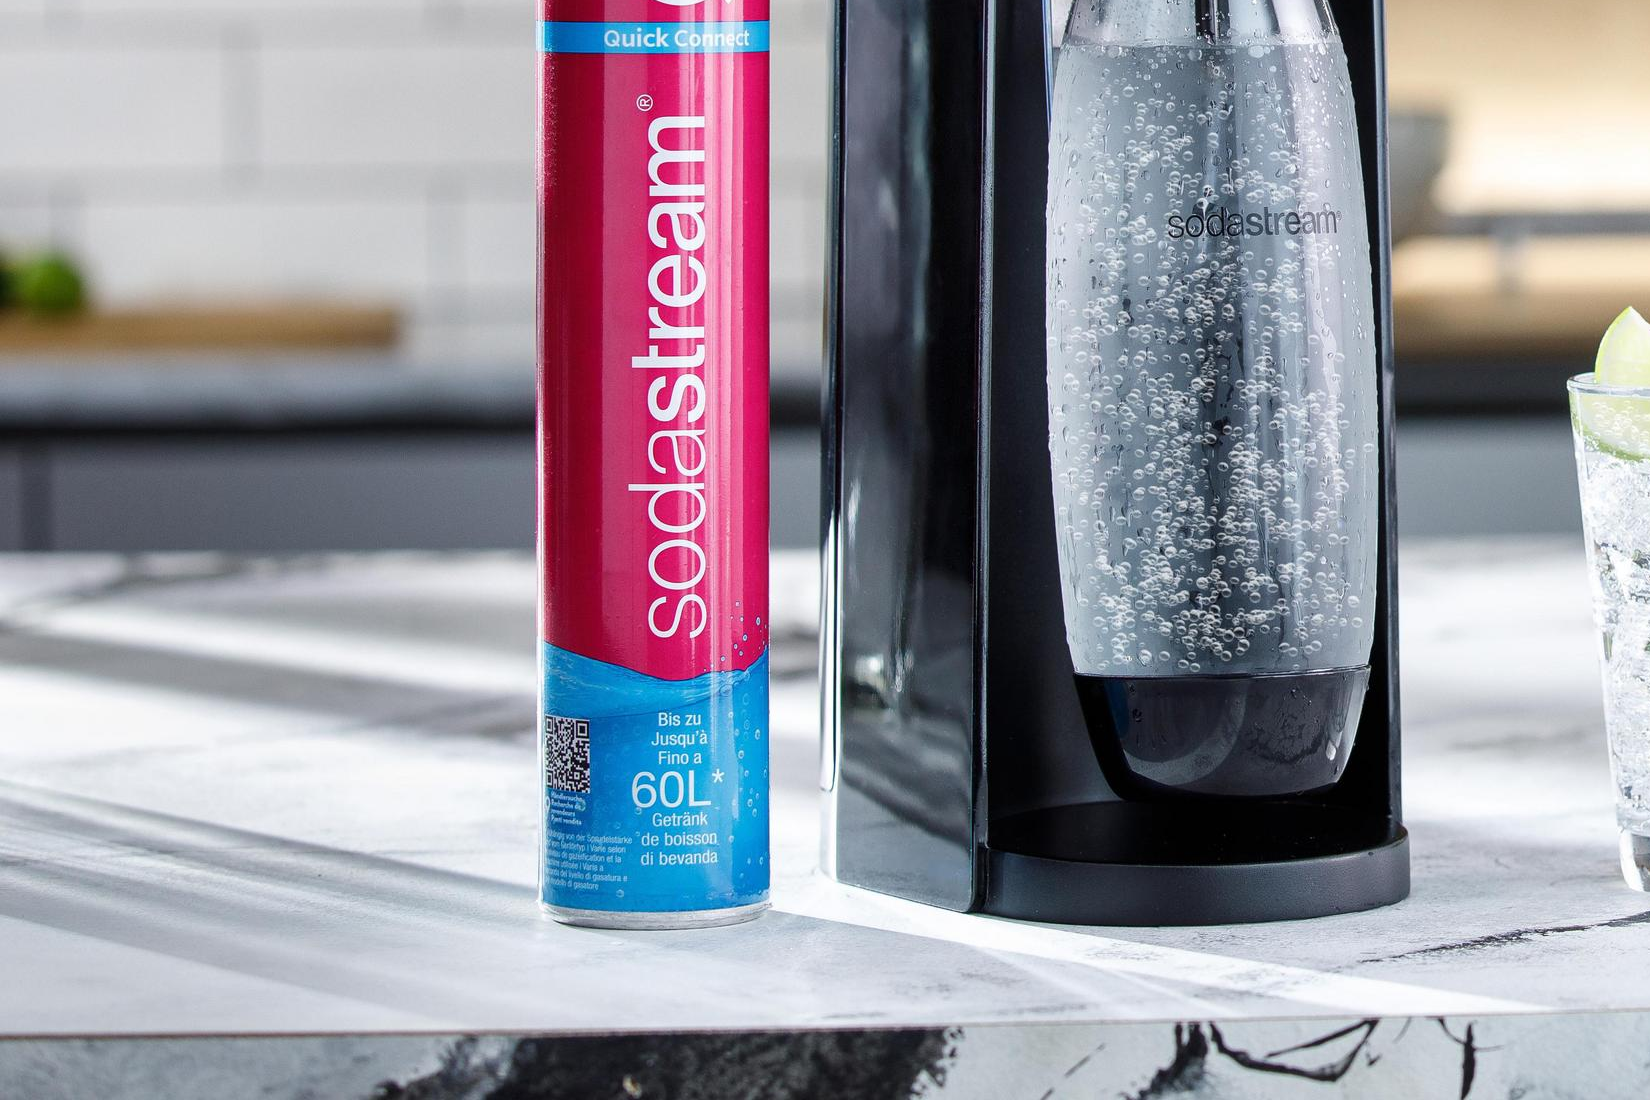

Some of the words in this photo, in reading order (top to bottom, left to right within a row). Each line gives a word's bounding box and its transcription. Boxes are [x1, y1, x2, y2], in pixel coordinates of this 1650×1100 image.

[604, 27, 670, 48] Quick
[674, 29, 750, 47] Connect
[658, 712, 681, 727] Bis
[685, 713, 702, 726] zu
[651, 729, 708, 748] Jusqu'à
[658, 751, 689, 765] Fino
[693, 753, 702, 765] a
[652, 812, 708, 827] Getränk
[641, 833, 660, 846] de
[664, 832, 717, 846] boisson
[641, 851, 654, 866] di
[659, 850, 718, 866] bevanda
